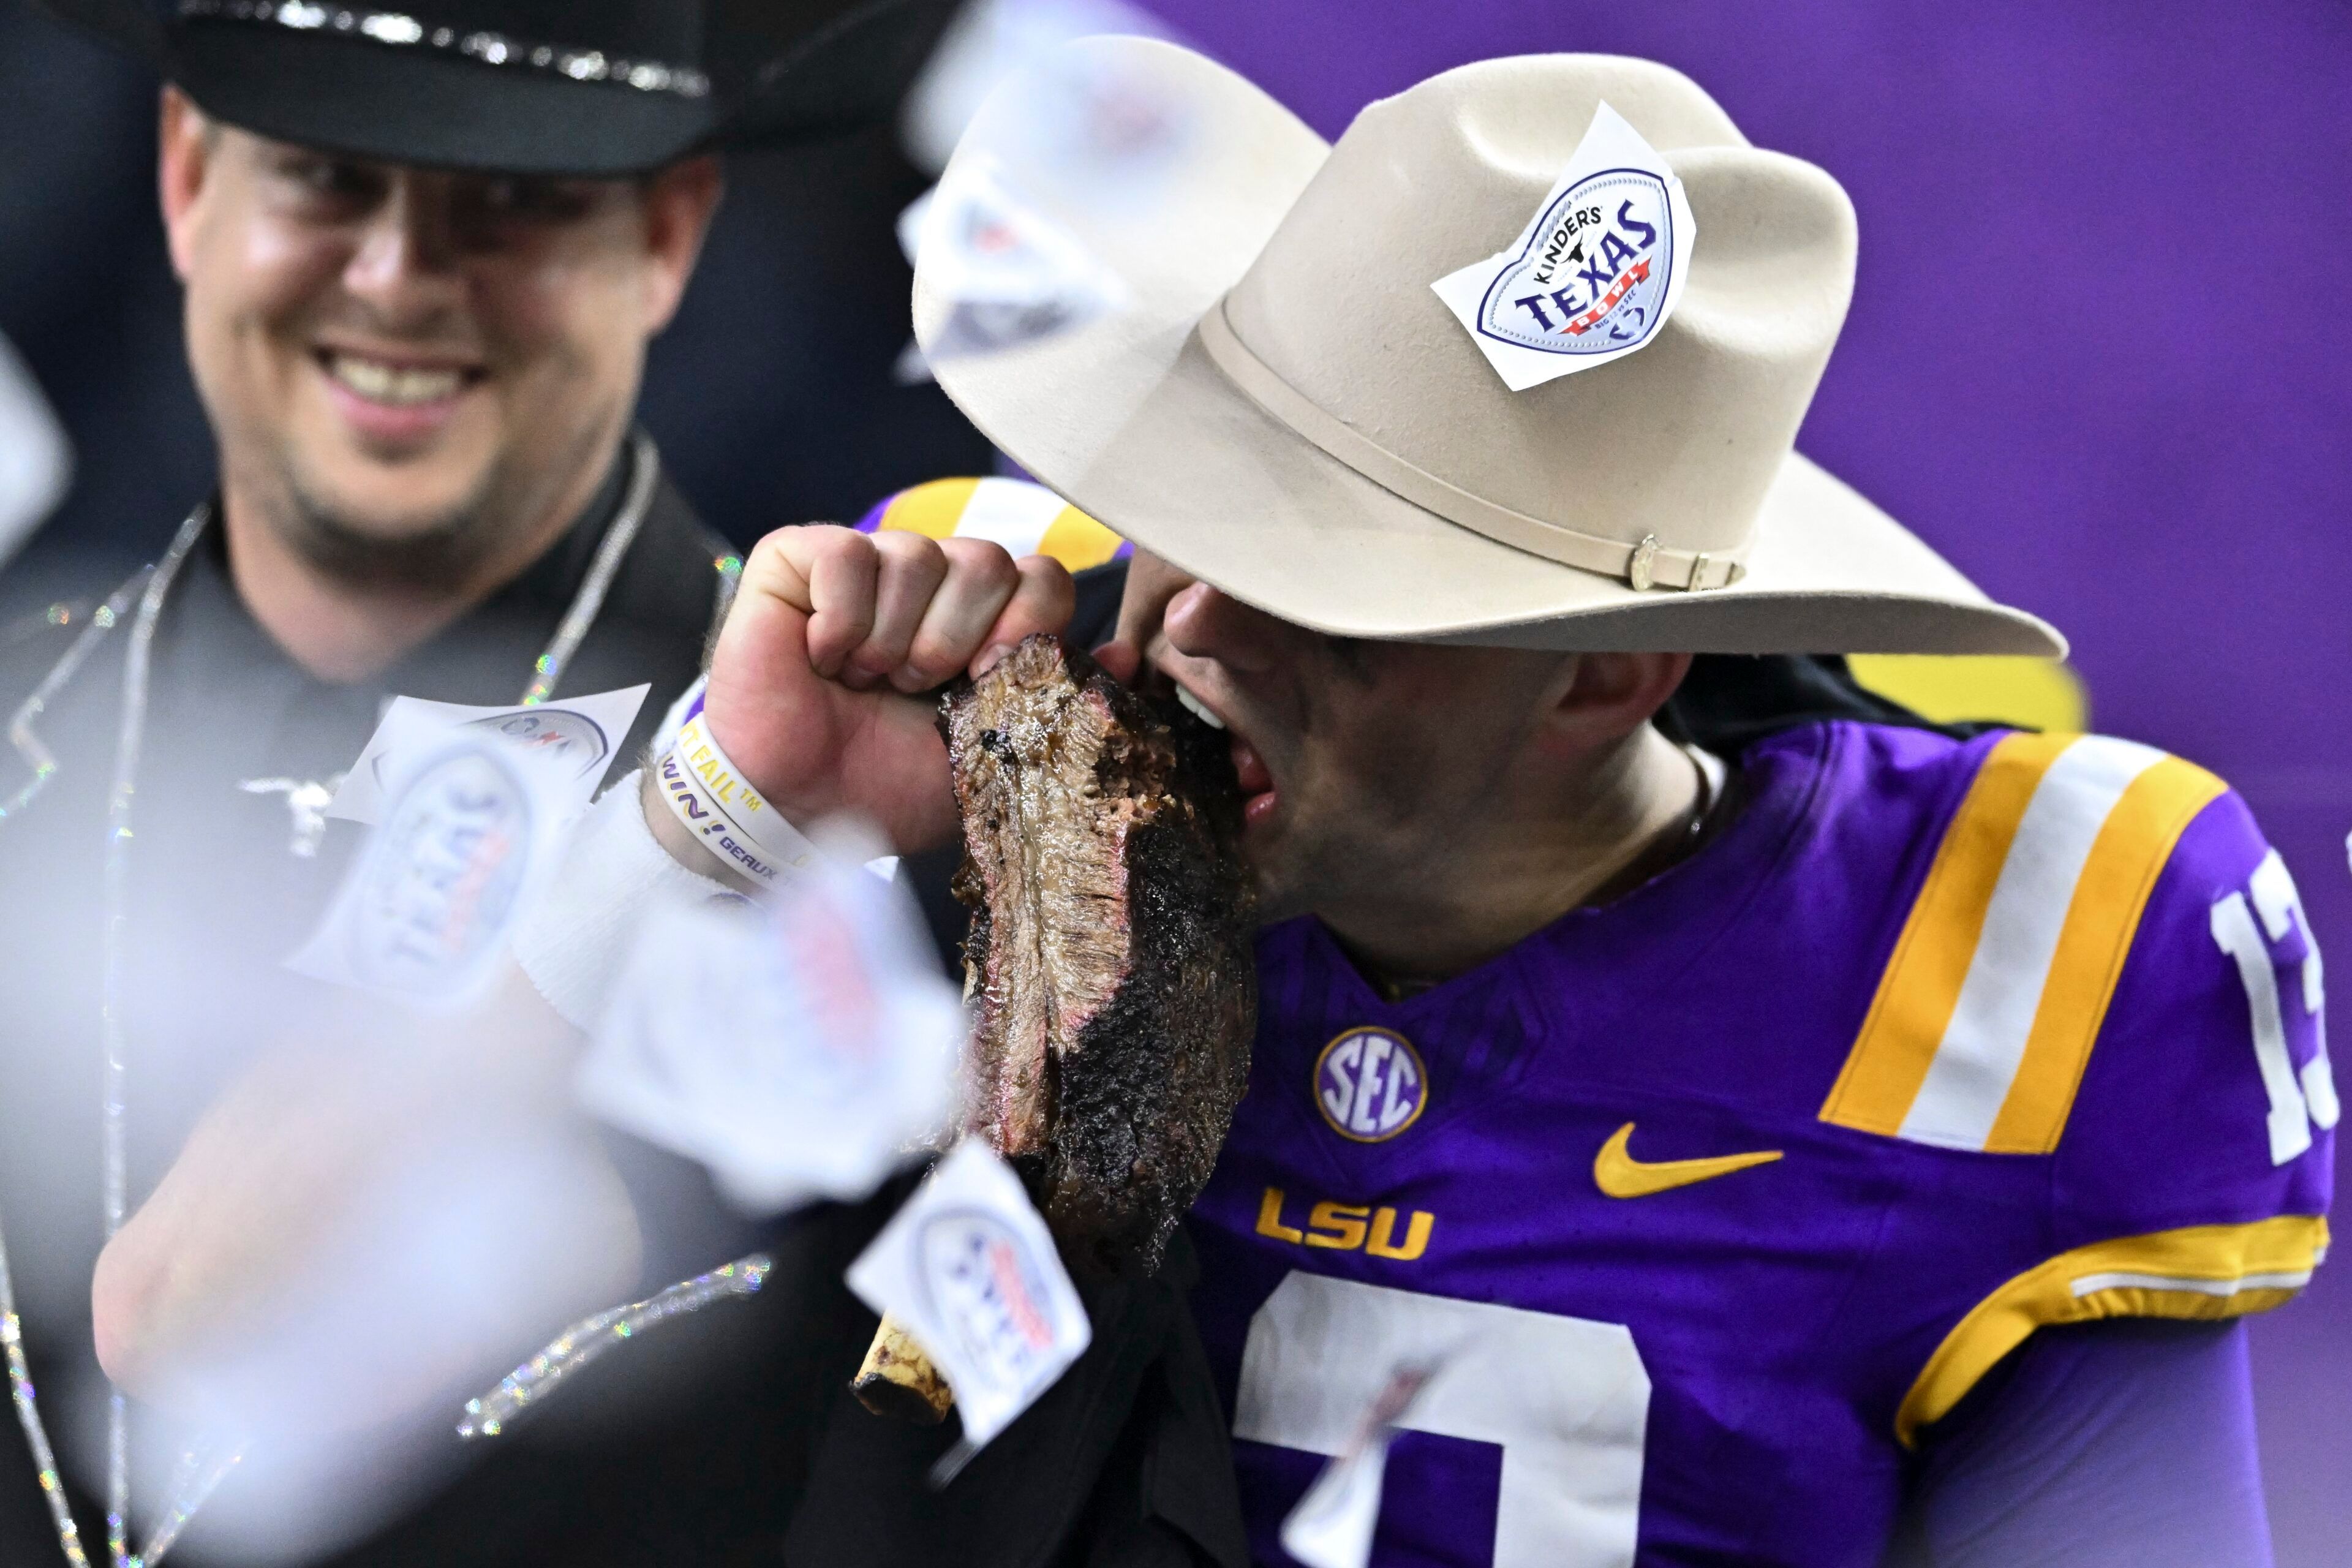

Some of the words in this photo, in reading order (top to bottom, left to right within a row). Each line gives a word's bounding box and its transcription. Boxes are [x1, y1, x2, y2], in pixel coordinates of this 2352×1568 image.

[1515, 199, 1656, 333] TEXAS
[1534, 206, 1601, 284] KINDER'S
[1576, 270, 1638, 326] BOWL
[1594, 318, 1609, 329] BIG
[1624, 289, 1636, 304] SEC
[690, 745, 736, 805] FAIL
[720, 837, 778, 881] GEAUX
[1322, 1035, 1417, 1133] SEC
[1256, 1186, 1435, 1261] LSU
